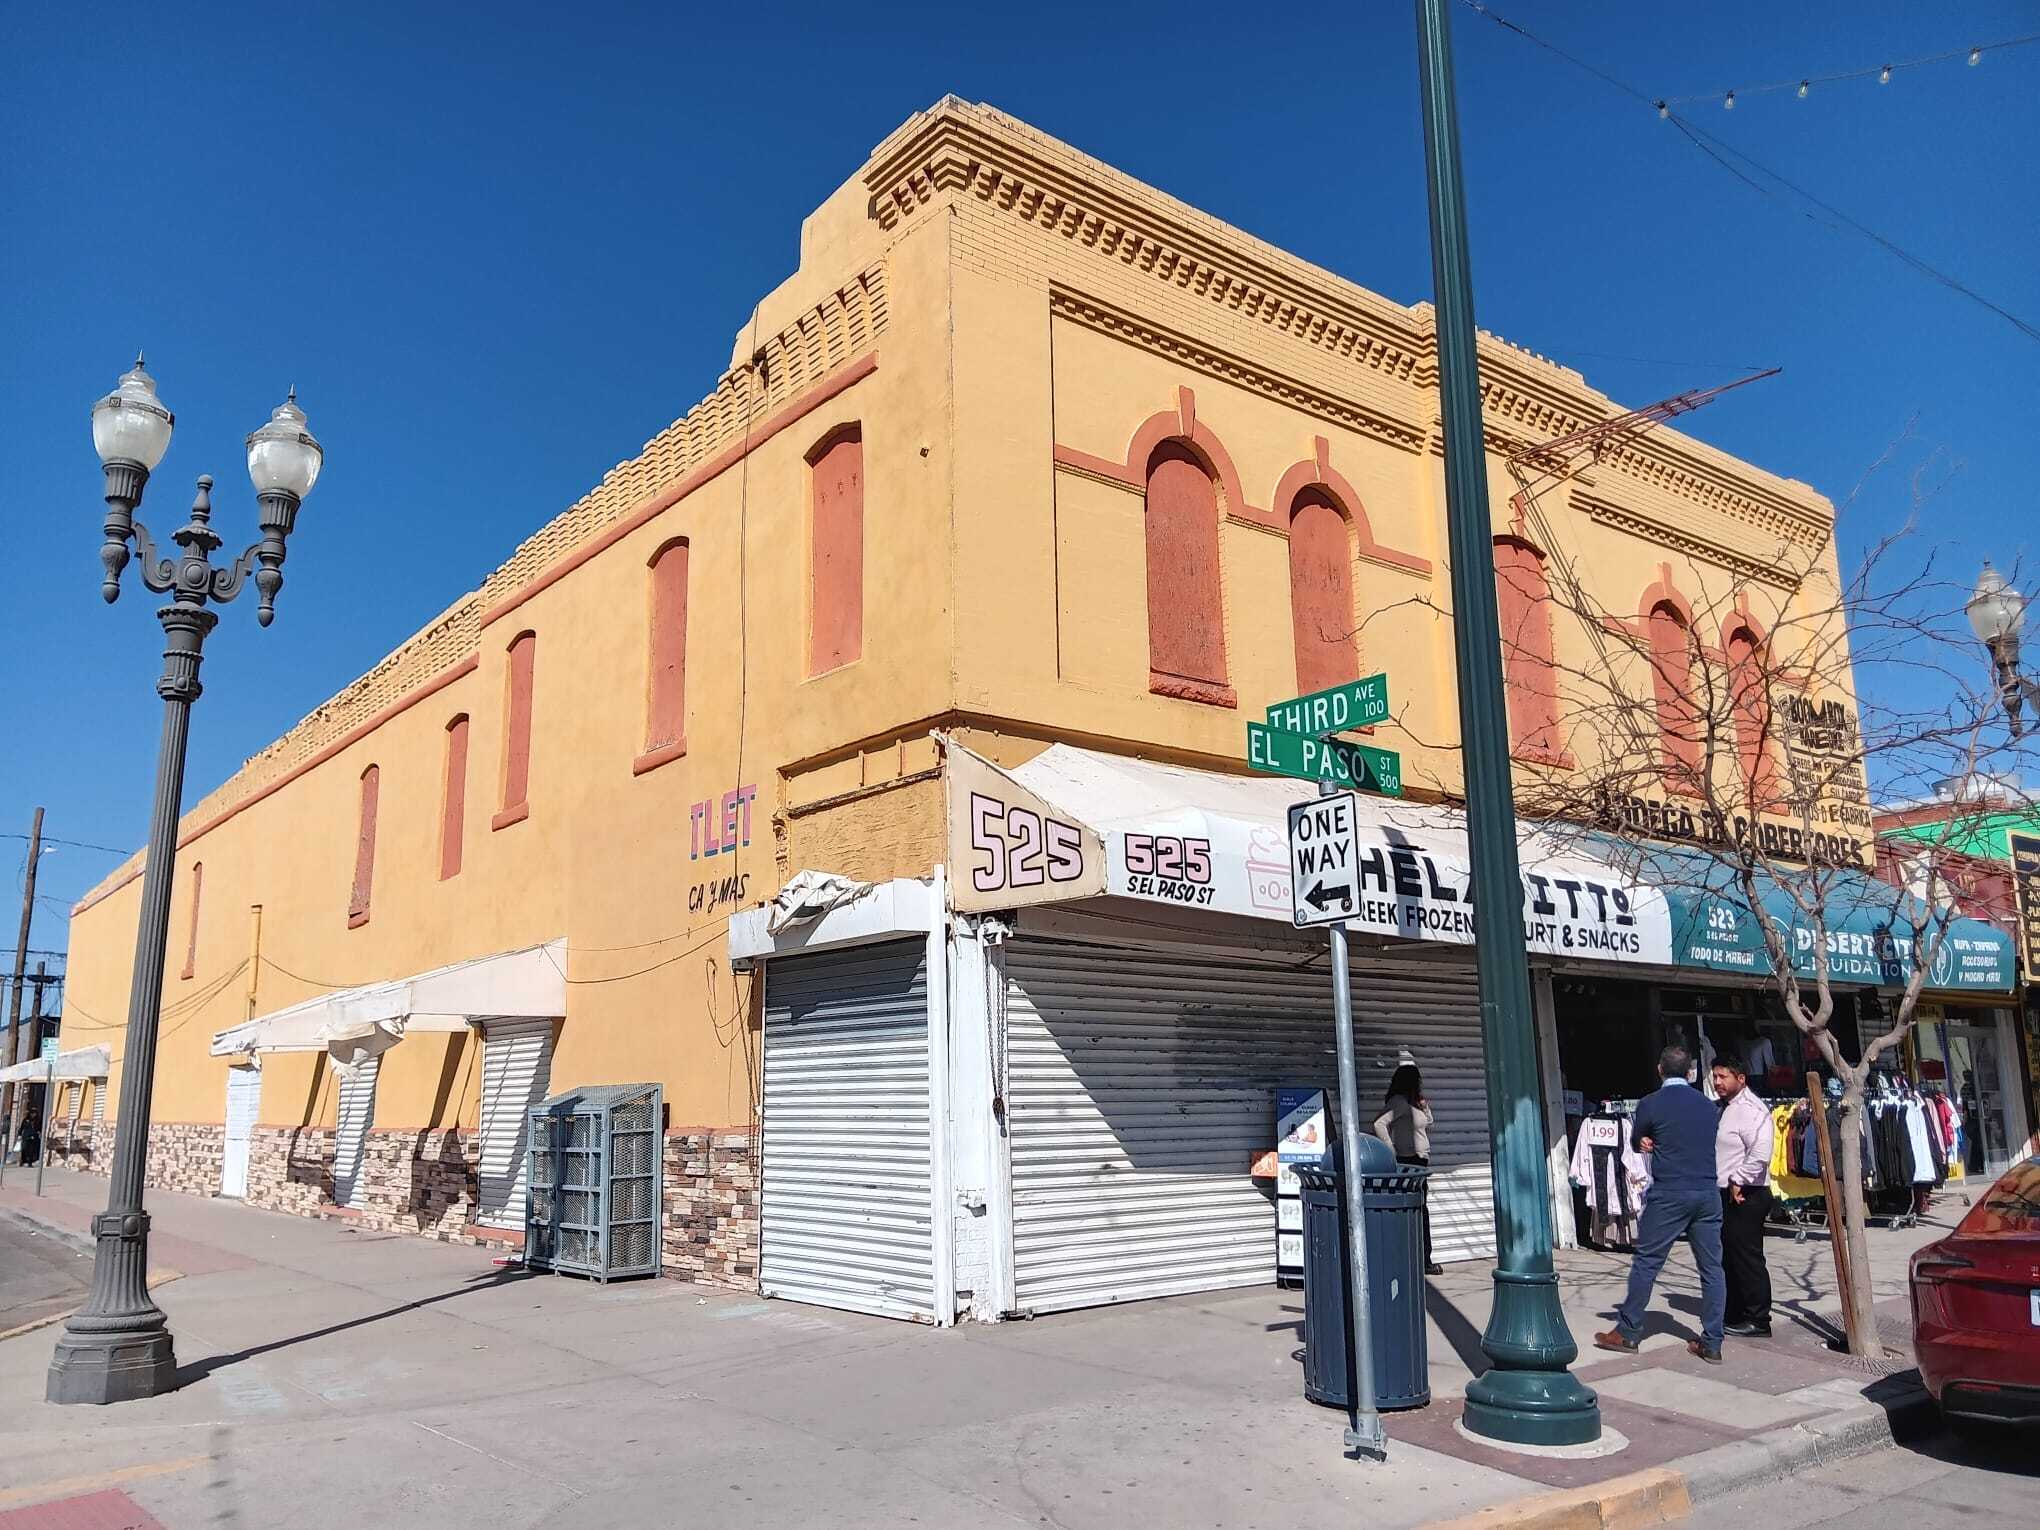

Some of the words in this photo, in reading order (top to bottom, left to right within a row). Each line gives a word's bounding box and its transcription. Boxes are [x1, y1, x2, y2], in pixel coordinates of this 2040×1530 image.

[1269, 692, 1348, 734] THIRD
[1354, 683, 1376, 702] AVE
[1364, 699, 1385, 718] 100
[1250, 729, 1281, 767] EL
[1302, 739, 1365, 783] PASO
[1380, 756, 1392, 771] ST
[1379, 773, 1398, 790] 500
[1298, 804, 1349, 841] ONE
[970, 791, 1084, 893] 525
[1297, 838, 1351, 876] WAY
[1124, 832, 1212, 885] 525
[718, 873, 750, 905] MAS
[1157, 879, 1196, 903] PASO
[1196, 886, 1216, 905] ST
[1361, 900, 1399, 926] EEK
[1406, 905, 1475, 934] FROZEN
[1523, 920, 1557, 944] URT
[1562, 924, 1574, 948] &
[1578, 927, 1640, 954] SNACKS
[1708, 906, 1736, 931] 523
[1691, 946, 1712, 961] TODO
[1713, 949, 1724, 963] DE
[1796, 927, 1875, 957] DSERT
[1801, 956, 1911, 978] LIUIDATION
[1591, 1126, 1616, 1139] 1.99
